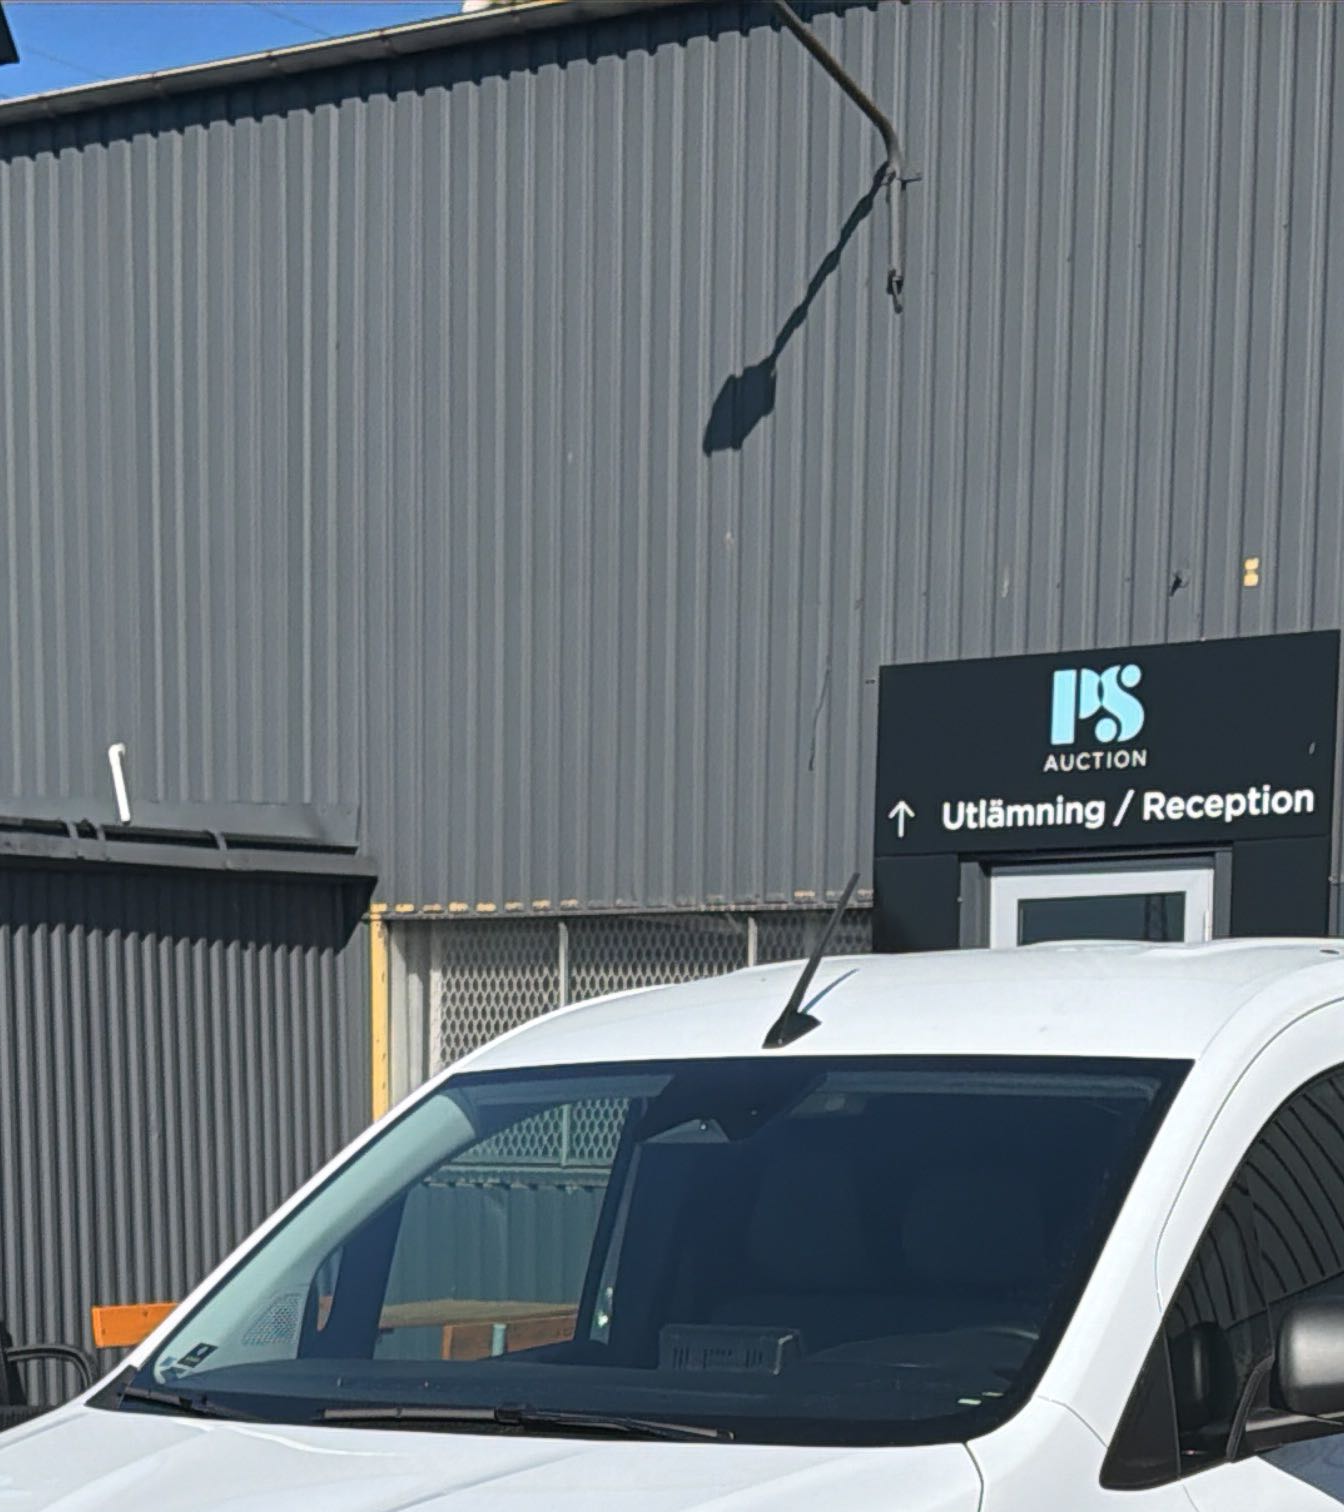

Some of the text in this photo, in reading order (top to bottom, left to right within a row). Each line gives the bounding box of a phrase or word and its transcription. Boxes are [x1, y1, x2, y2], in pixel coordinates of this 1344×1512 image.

[1050, 664, 1146, 745] PS
[1043, 749, 1147, 773] AUCTION
[941, 784, 1314, 831] Utlämning / Reception
